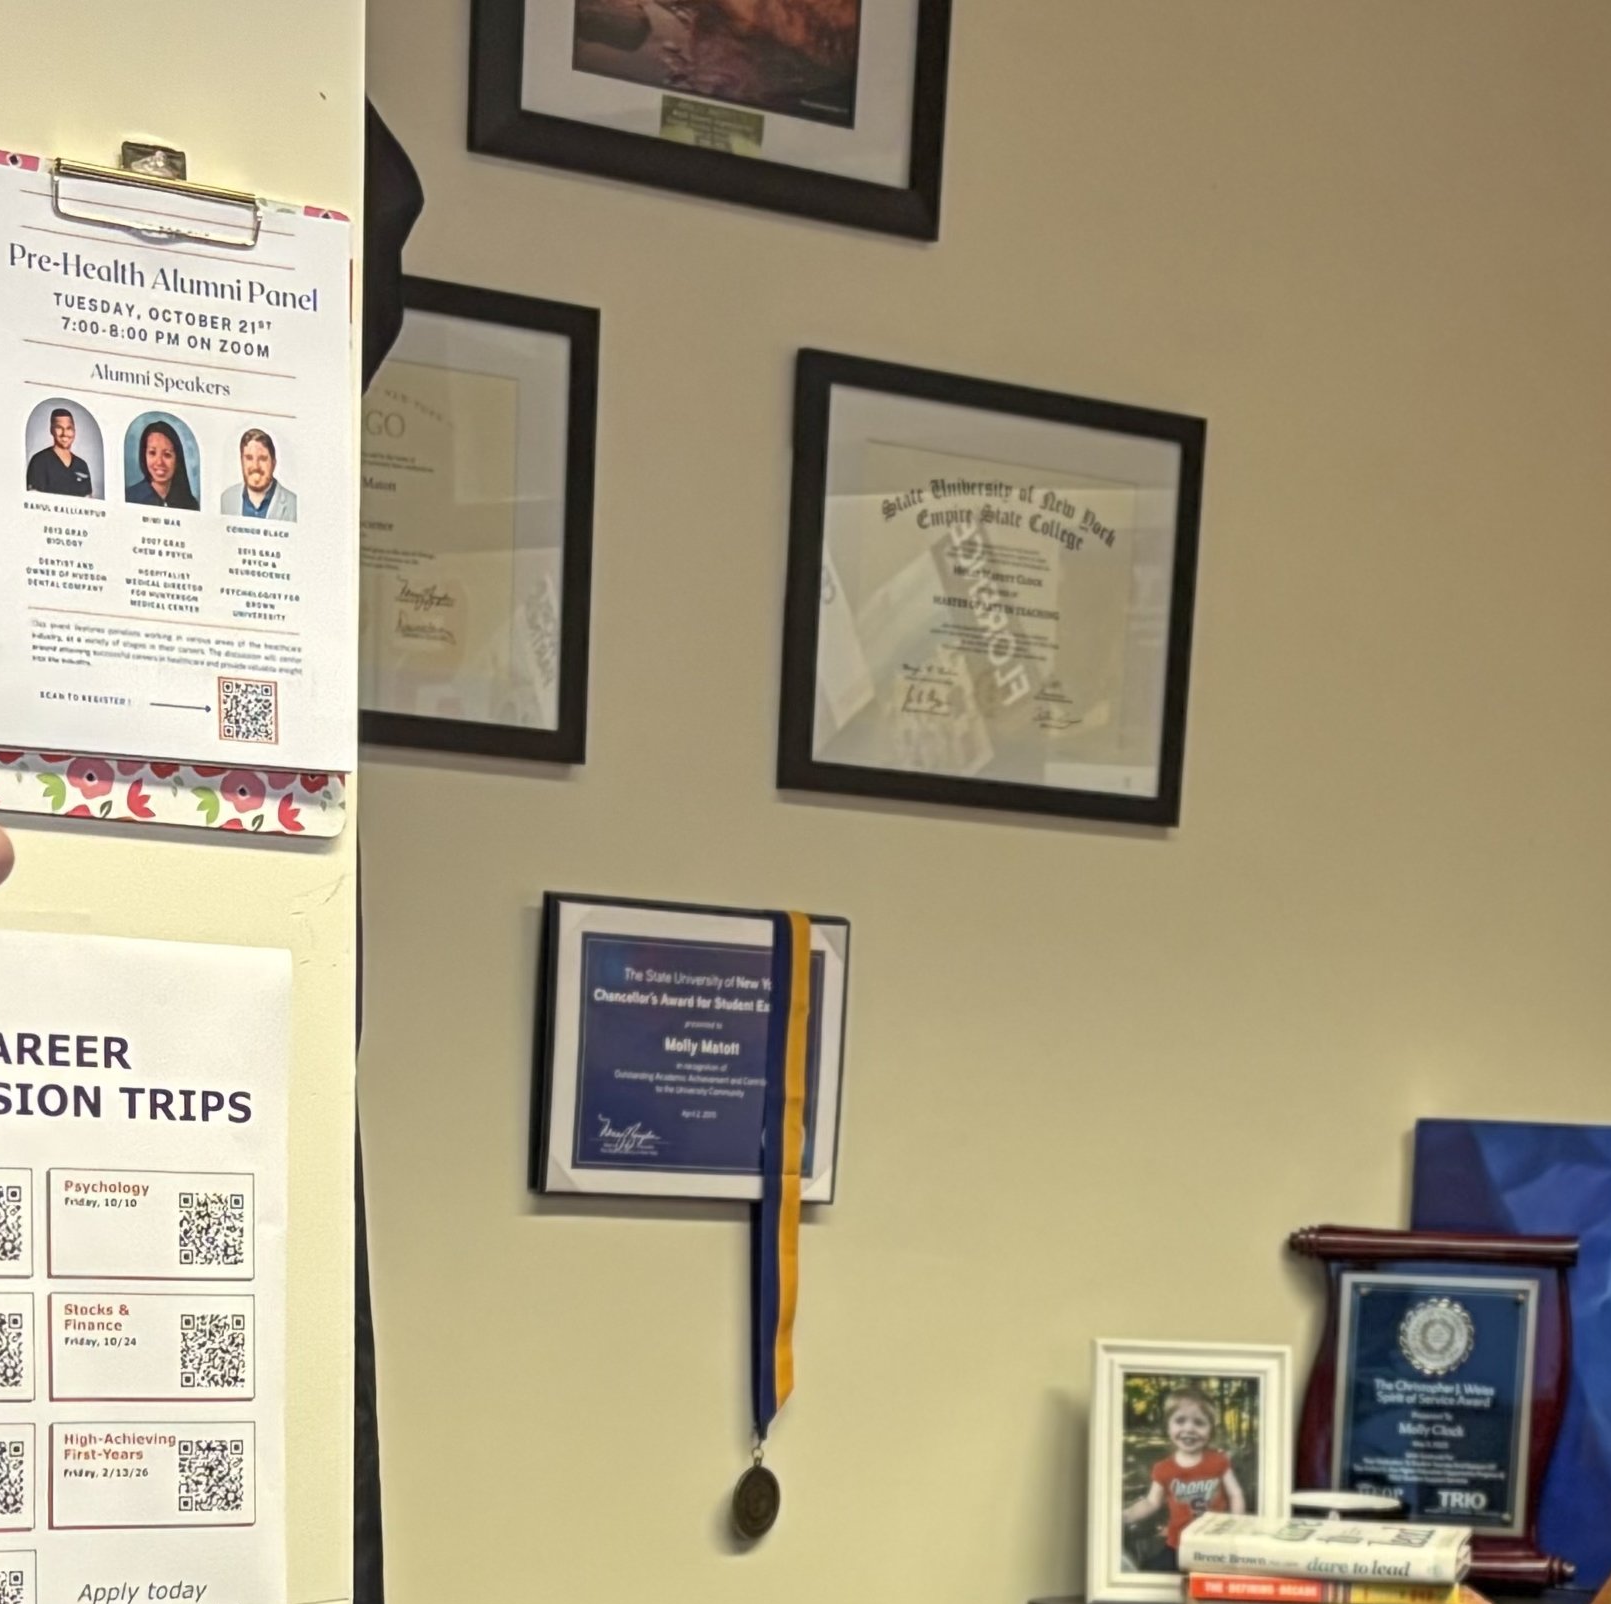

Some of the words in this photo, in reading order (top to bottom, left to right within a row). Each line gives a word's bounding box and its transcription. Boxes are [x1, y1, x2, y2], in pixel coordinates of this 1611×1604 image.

[9, 243, 145, 288] Pre-Health
[151, 268, 242, 301] Alumni
[248, 281, 318, 312] Panel
[53, 292, 141, 320] TUESDAY,
[148, 307, 232, 331] OCTOBER
[238, 319, 272, 335] 21ST
[60, 317, 148, 341] 7:00-8:00
[155, 331, 180, 346] PM
[187, 335, 211, 350] ON
[219, 339, 270, 359] ZOOM
[90, 363, 150, 387] Alumni
[154, 372, 231, 396] Speakers
[881, 488, 924, 521] State
[929, 478, 1013, 503] University
[1018, 485, 1036, 504] of
[1040, 491, 1076, 519] New
[1078, 508, 1117, 548] York
[65, 528, 88, 537] GRAD
[916, 508, 973, 529] Empire
[978, 504, 1023, 529] State
[1028, 514, 1084, 551] College
[46, 537, 83, 547] BIOLOGY
[38, 557, 74, 568] DENTIST
[27, 578, 60, 588] DENTAL
[62, 582, 104, 592] COMPANY
[125, 578, 161, 588] MEDICAL
[130, 599, 166, 610] MEDICAL
[168, 604, 200, 613] CENTER
[40, 690, 65, 700] SCAN
[67, 693, 80, 702] TO
[81, 695, 126, 706] REGISTER
[625, 967, 643, 982] The
[645, 969, 672, 984] State
[674, 971, 723, 990] University
[724, 975, 735, 987] of
[735, 977, 759, 990] New
[594, 988, 658, 1006] Chancellor's
[660, 993, 694, 1008] Award
[696, 995, 712, 1009] for
[714, 997, 754, 1012] Student
[665, 1036, 699, 1057] Molly
[118, 1086, 252, 1124] TRIPS
[64, 1180, 150, 1197] Psychology
[64, 1198, 100, 1209] Friday,
[104, 1198, 137, 1208] 10/10
[64, 1304, 114, 1316] Stocks
[118, 1304, 130, 1316] &
[64, 1319, 123, 1332] Finance
[64, 1337, 100, 1348] Friday,
[104, 1336, 137, 1347] 10/24
[1374, 1378, 1394, 1391] The
[1418, 1394, 1455, 1406] Service
[1457, 1395, 1491, 1408] Award
[1398, 1422, 1431, 1437] Molly
[64, 1433, 177, 1447] High-Achieving
[64, 1448, 144, 1461] First-Years
[63, 1467, 99, 1479] Friday,
[102, 1467, 149, 1479] 2/13/26
[1437, 1490, 1487, 1509] TRIO
[1228, 1552, 1267, 1566] Brown
[1307, 1556, 1348, 1575] dare
[1351, 1561, 1369, 1576] to
[1371, 1559, 1411, 1578] lead
[77, 1582, 140, 1604] Apply
[147, 1581, 208, 1603] today
[1204, 1581, 1224, 1593] THE
